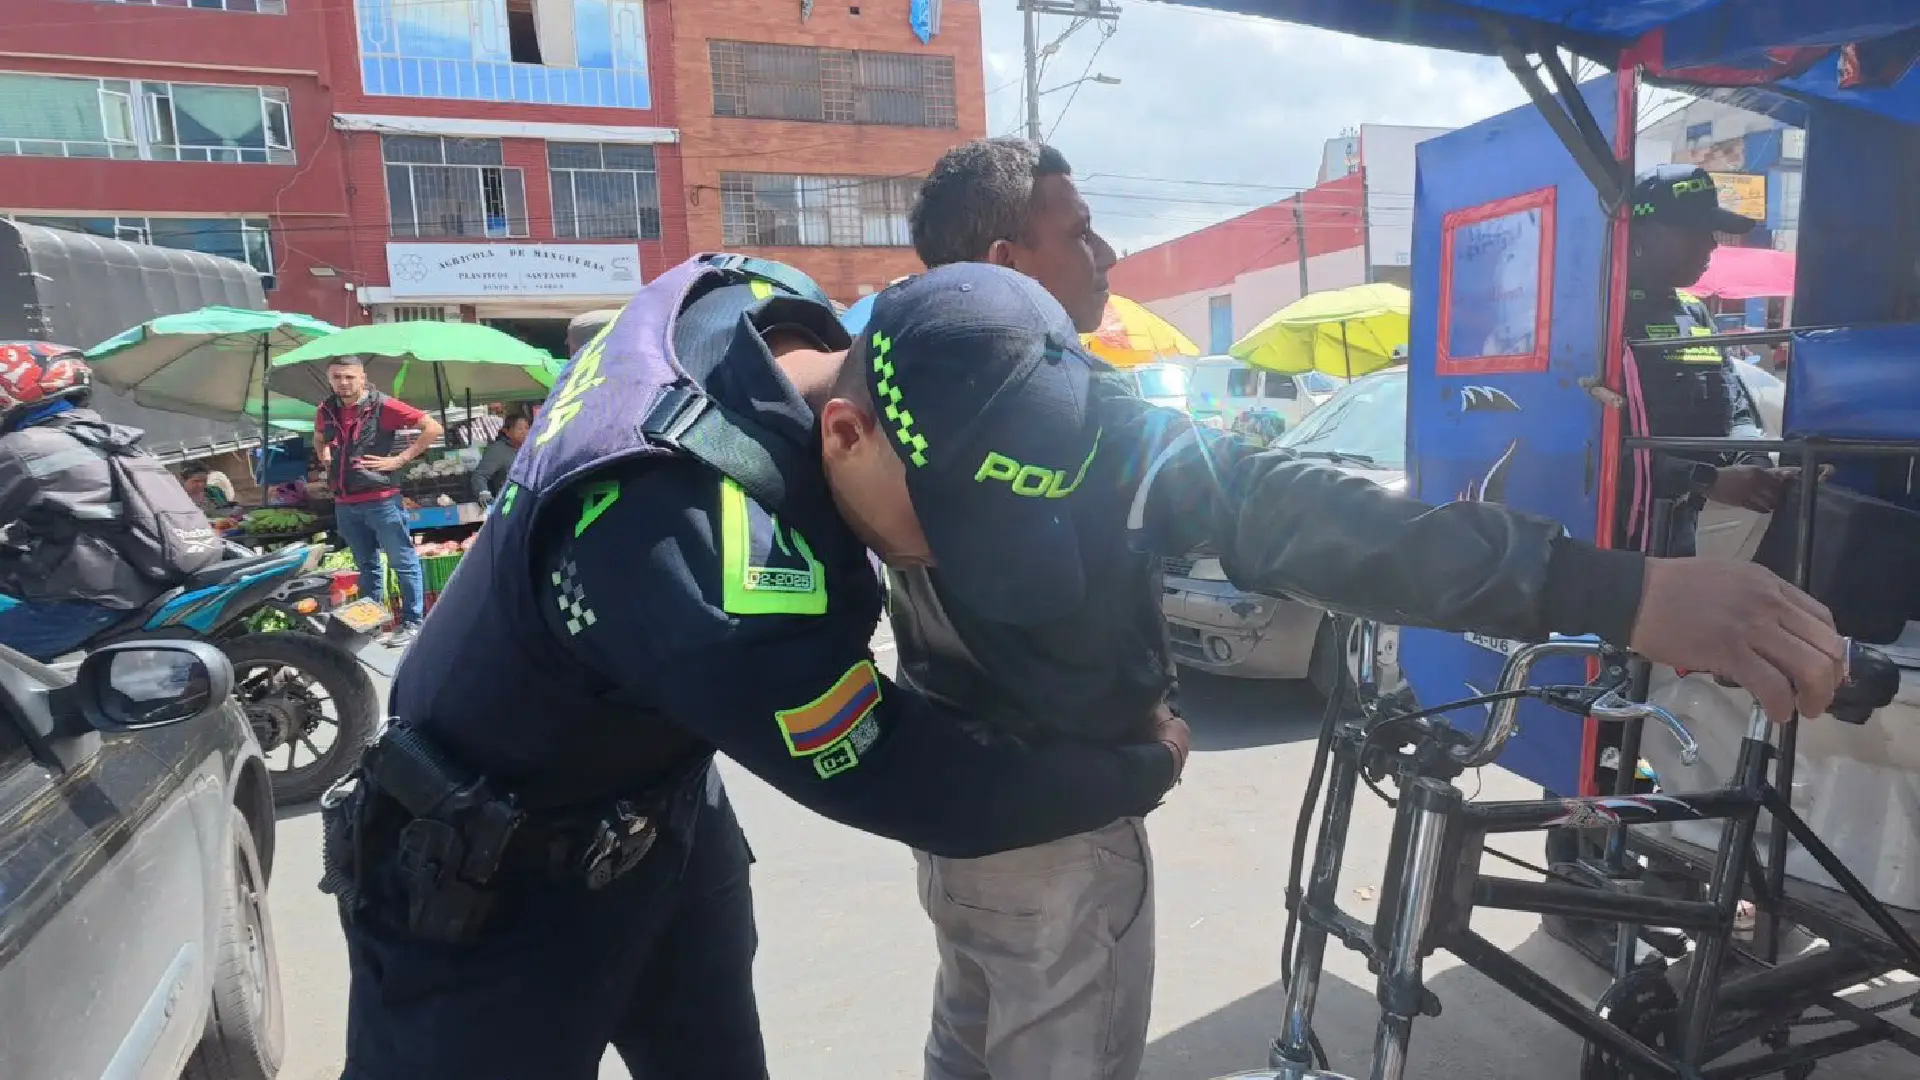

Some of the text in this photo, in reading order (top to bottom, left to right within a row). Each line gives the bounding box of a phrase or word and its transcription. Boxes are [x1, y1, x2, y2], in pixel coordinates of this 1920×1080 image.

[508, 249, 525, 259] DE
[525, 271, 578, 280] SANTANDER
[751, 572, 810, 587] 02-2025
